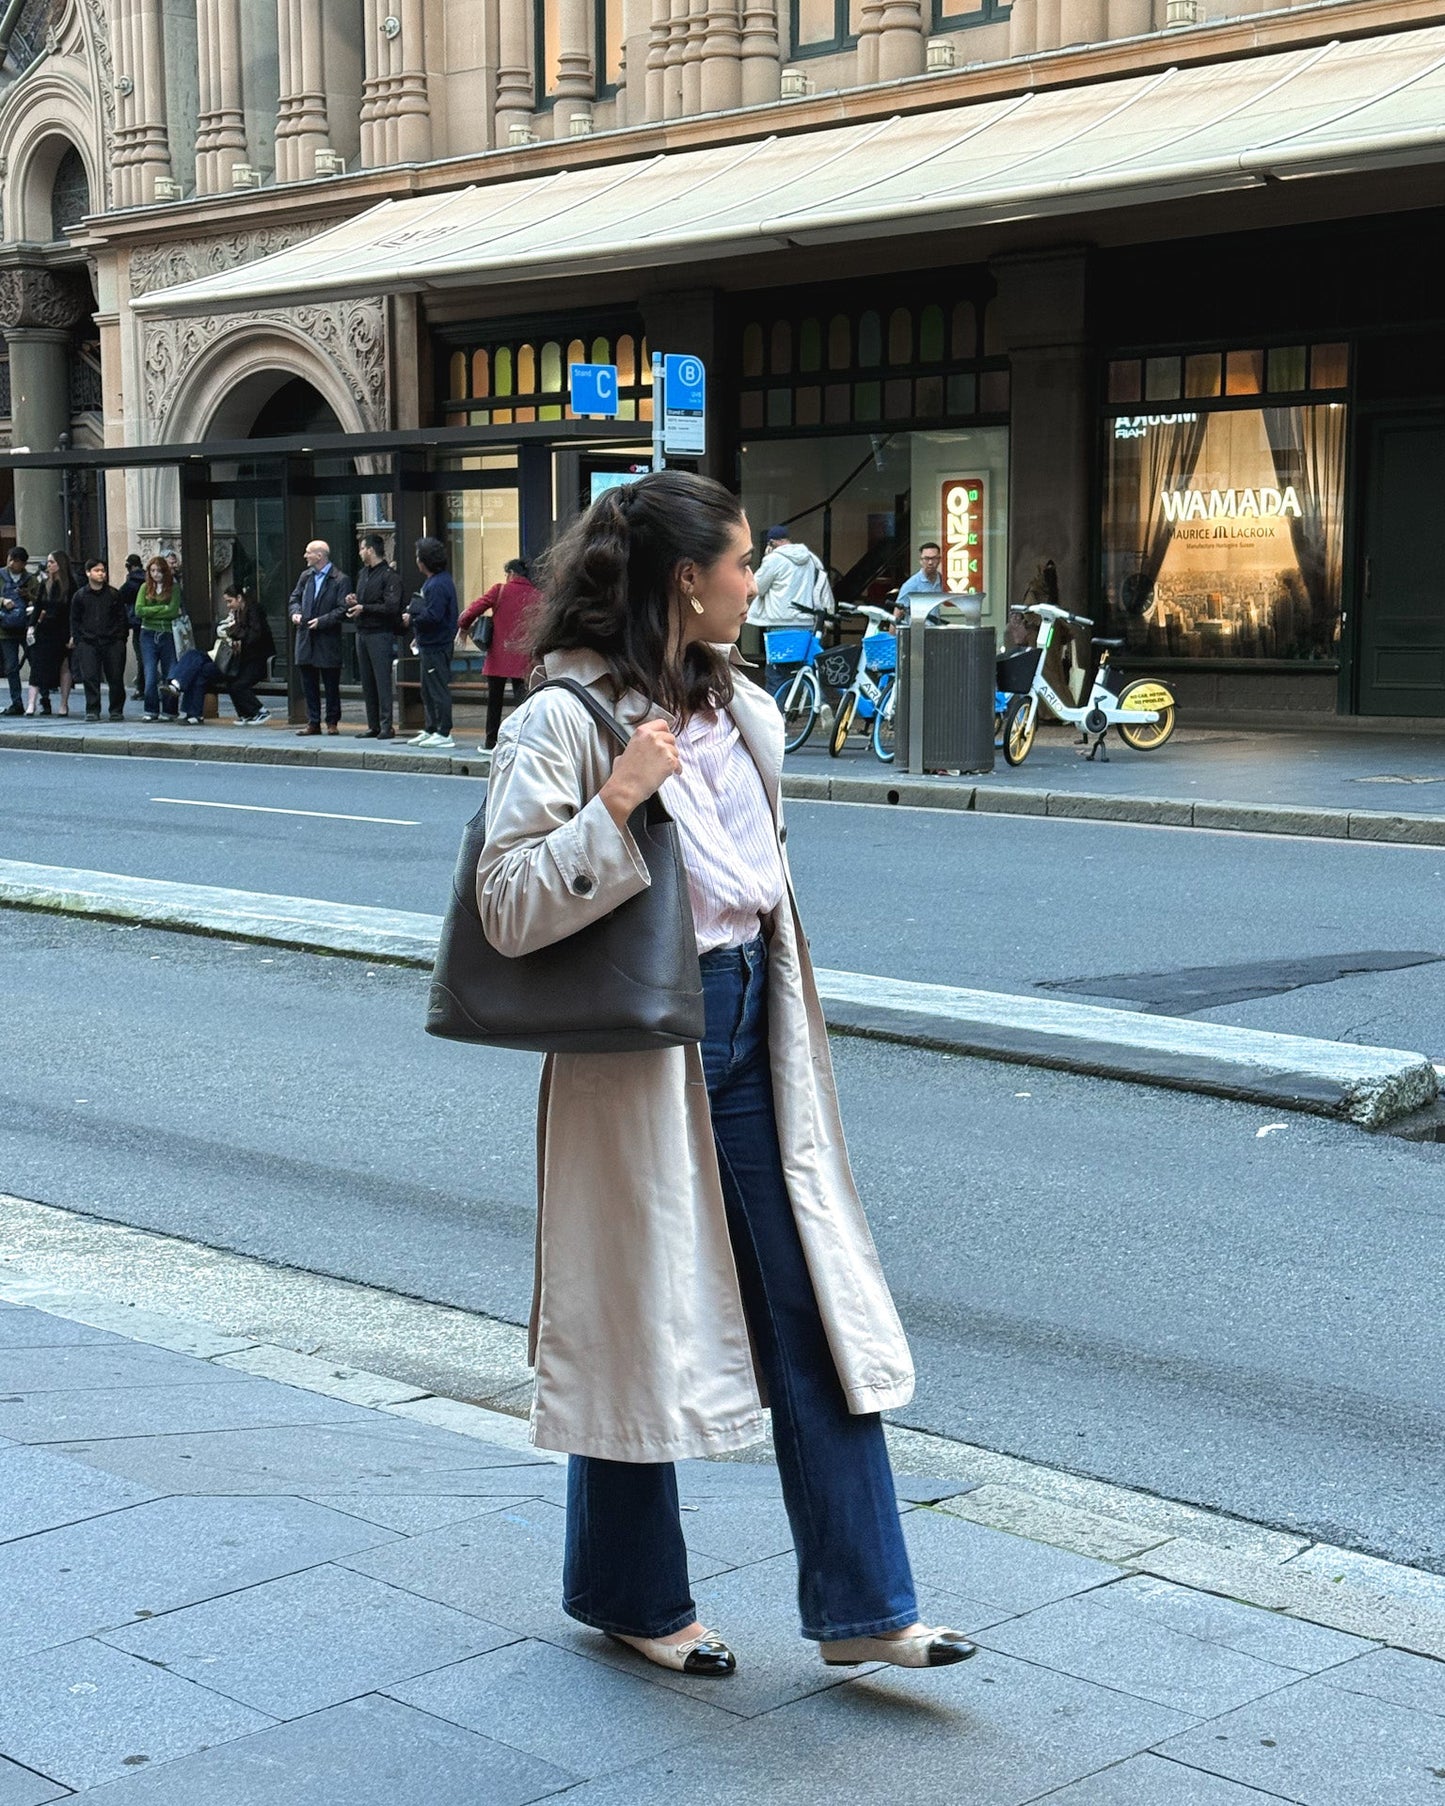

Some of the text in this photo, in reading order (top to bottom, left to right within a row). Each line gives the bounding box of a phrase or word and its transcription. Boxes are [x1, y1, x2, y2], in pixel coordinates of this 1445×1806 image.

[574, 369, 592, 377] Stand
[597, 370, 611, 398] C
[686, 366, 695, 380] B
[1161, 486, 1302, 522] WAMADA
[947, 487, 969, 593] KENZO
[968, 490, 978, 594] PARIS
[1231, 527, 1275, 539] LACROIX
[1040, 686, 1063, 711] ARIO
